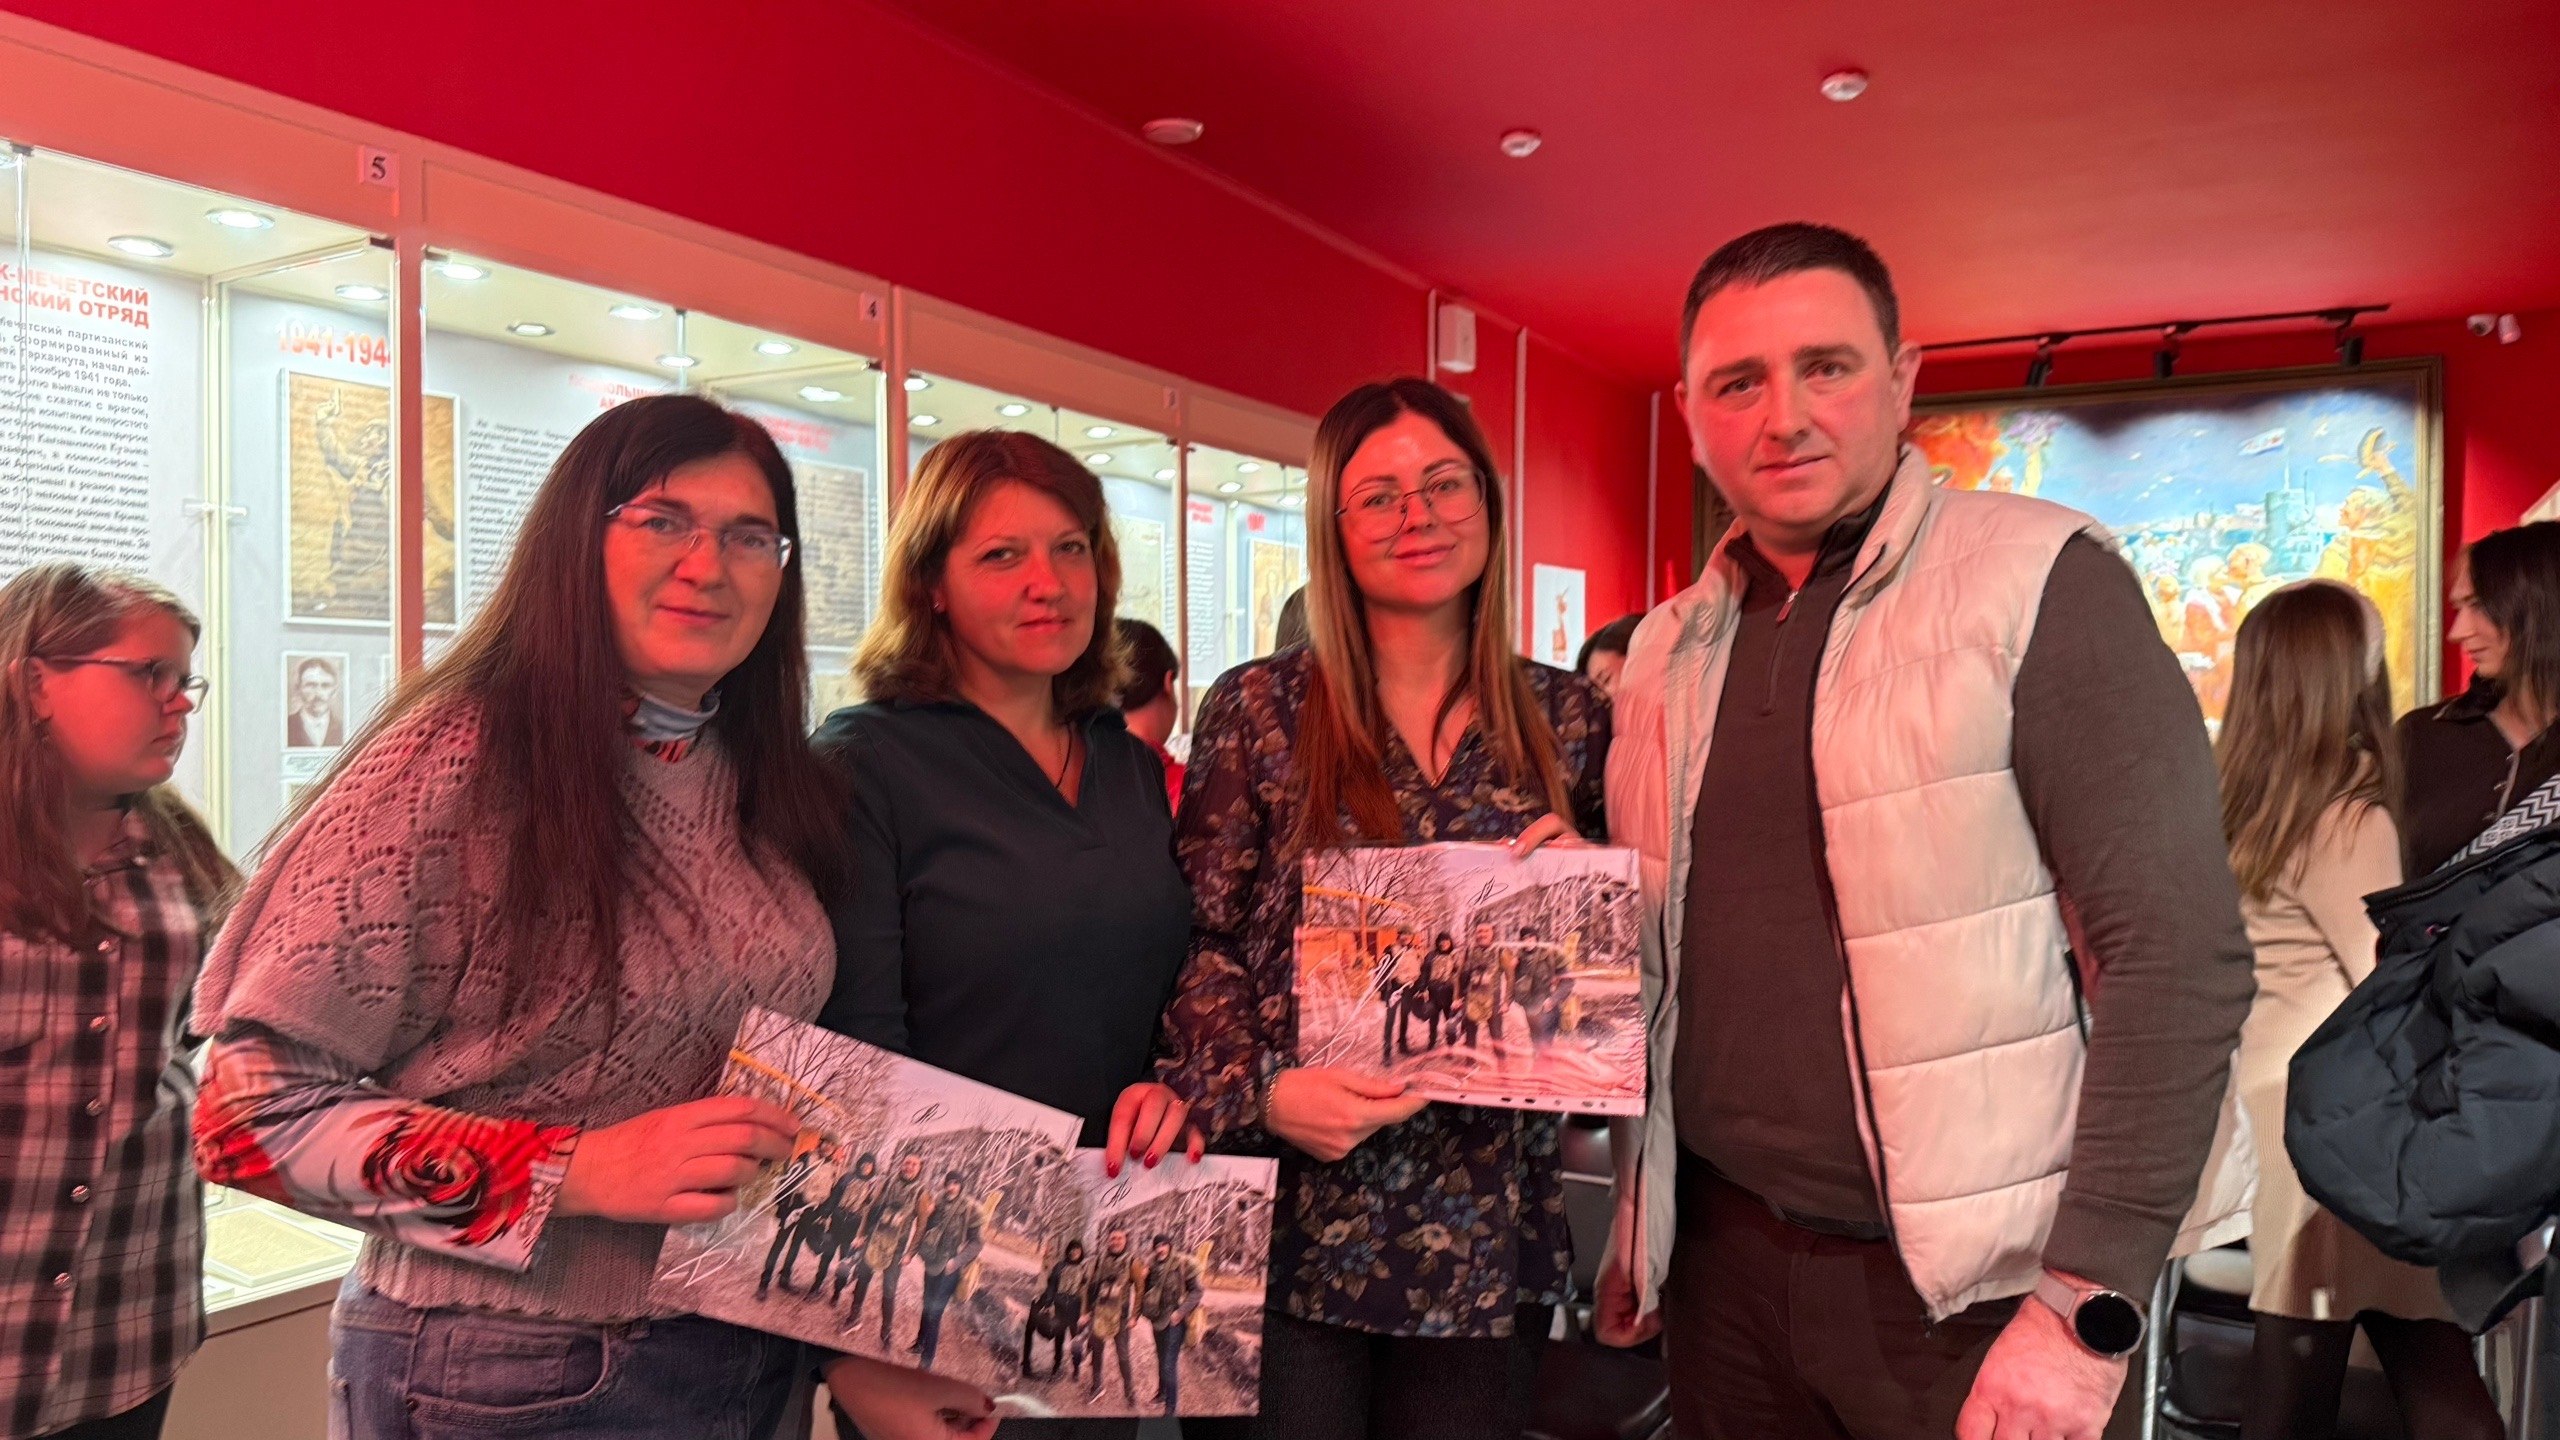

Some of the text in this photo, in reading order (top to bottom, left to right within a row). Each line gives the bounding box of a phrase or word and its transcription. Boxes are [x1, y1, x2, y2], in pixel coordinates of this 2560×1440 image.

[372, 156, 386, 180] 5
[79, 300, 150, 329] ОТРЯД
[868, 300, 877, 318] 4
[68, 329, 149, 351] партизанский
[278, 320, 391, 368] 1941-194
